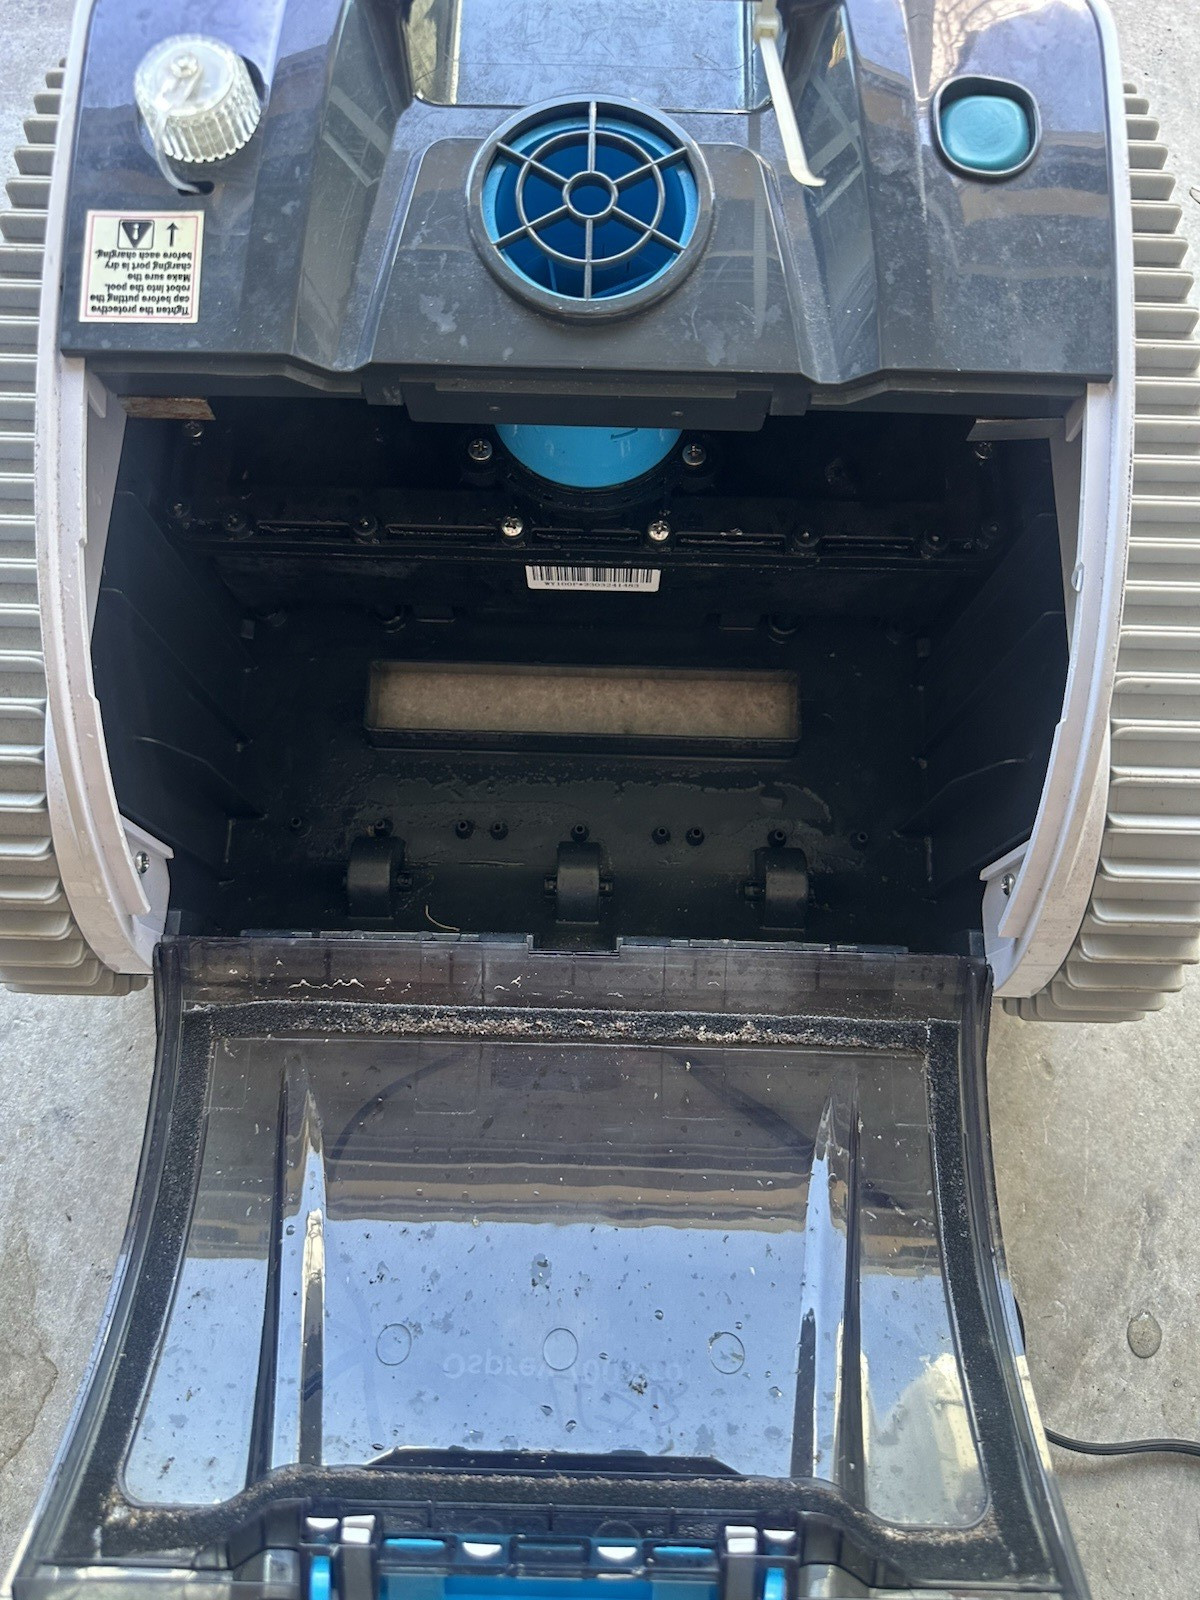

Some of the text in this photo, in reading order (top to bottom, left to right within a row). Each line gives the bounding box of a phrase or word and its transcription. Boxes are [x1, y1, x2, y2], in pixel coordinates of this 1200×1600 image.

[95, 250, 192, 260] before each charging.
[105, 260, 192, 271] charging port is dry
[127, 273, 142, 281] the
[167, 273, 191, 282] Make
[105, 283, 190, 293] robot into the pool.
[90, 292, 190, 304] cap before putting the
[91, 304, 189, 316] Tighten the protective
